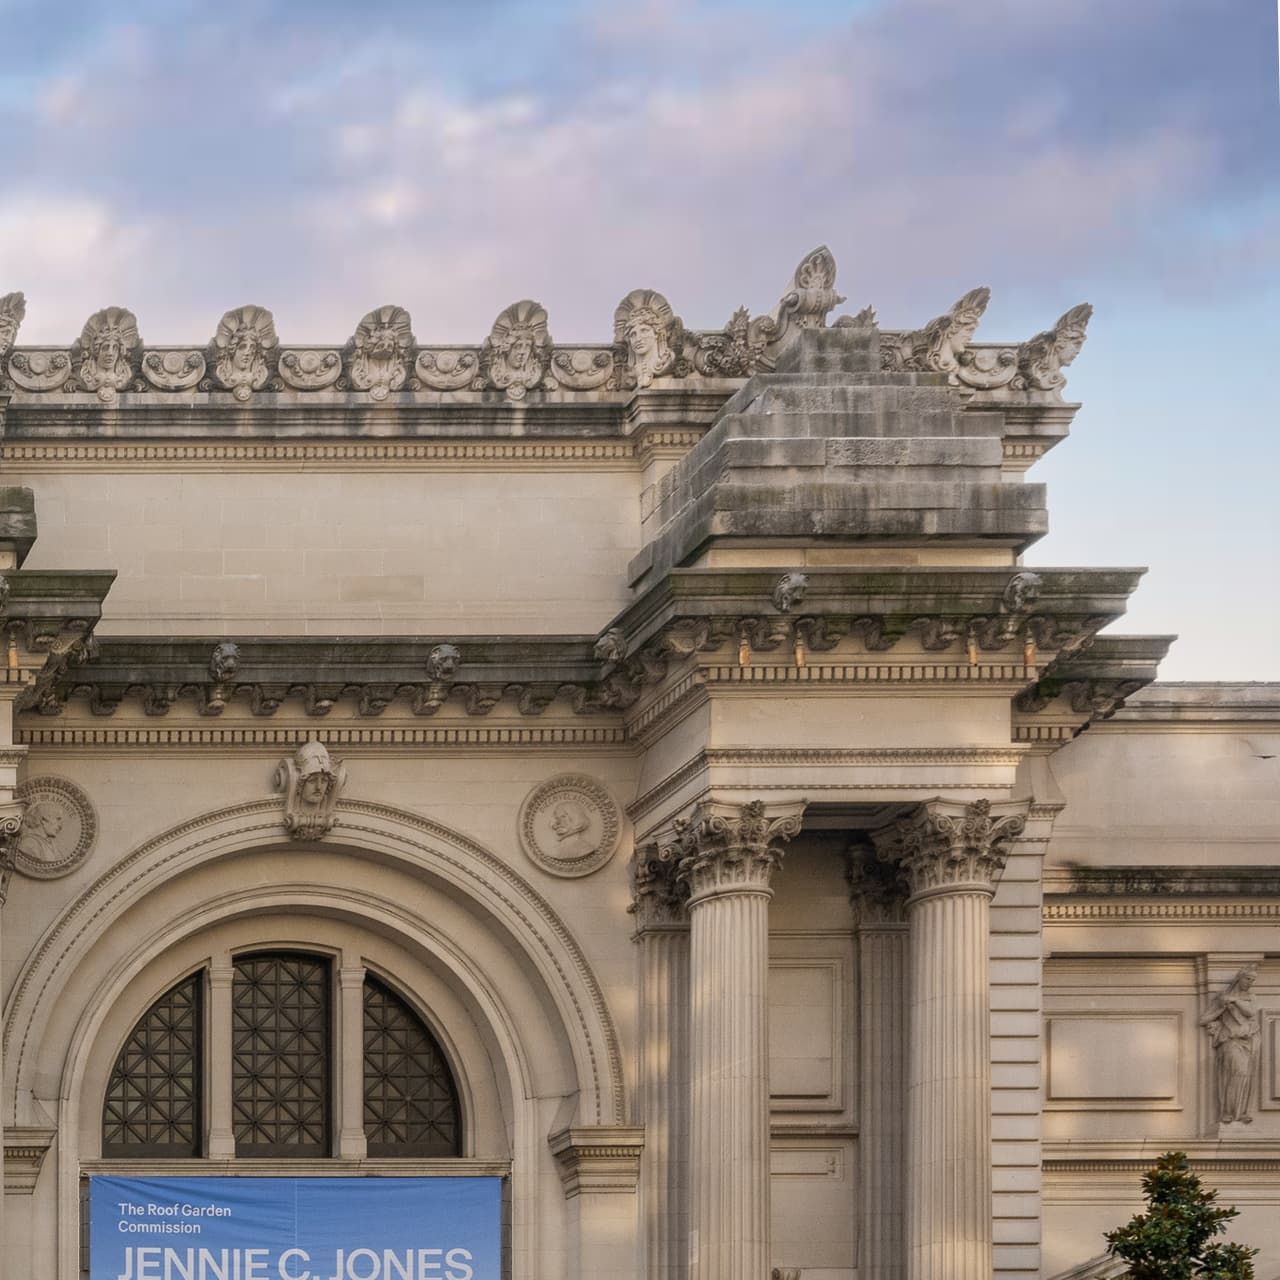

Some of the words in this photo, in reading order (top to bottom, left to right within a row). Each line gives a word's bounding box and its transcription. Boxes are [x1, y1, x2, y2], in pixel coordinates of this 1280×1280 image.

[118, 1203, 145, 1216] The
[147, 1203, 179, 1216] Roof
[181, 1204, 232, 1217] Garden
[118, 1220, 201, 1234] Commission
